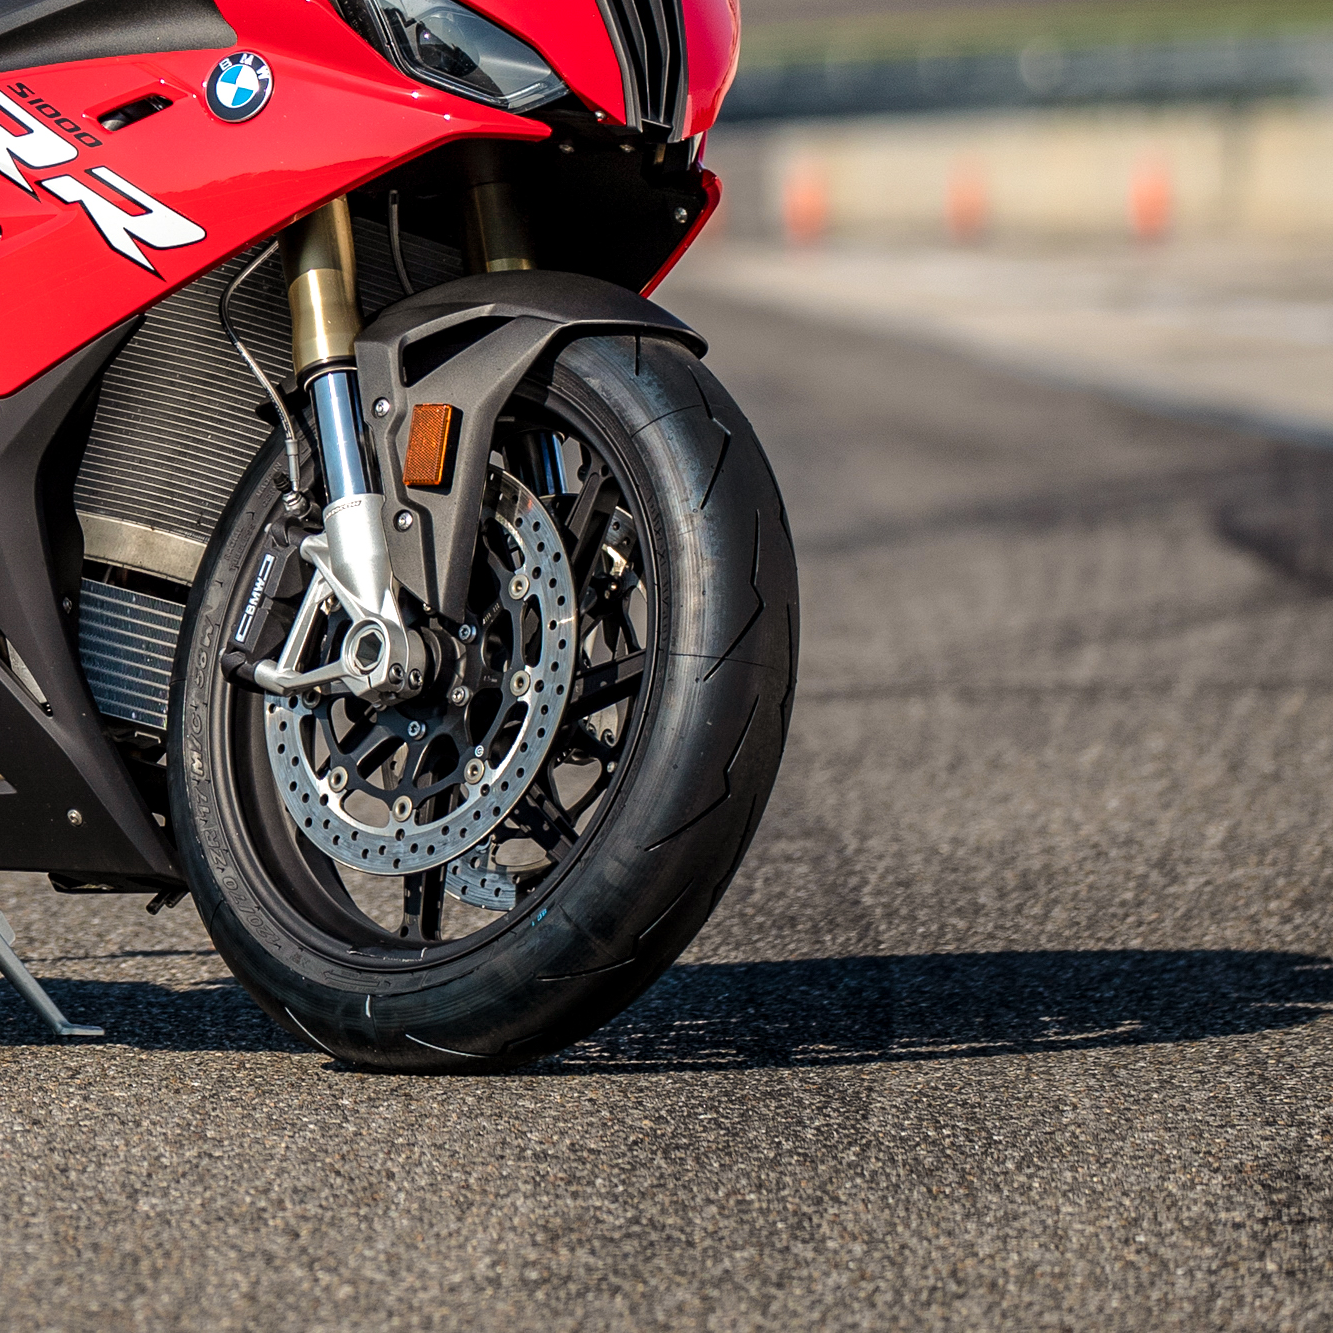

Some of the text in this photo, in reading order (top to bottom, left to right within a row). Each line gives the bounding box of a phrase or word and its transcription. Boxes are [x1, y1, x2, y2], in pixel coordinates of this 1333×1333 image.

[219, 53, 270, 81] BMW
[7, 82, 103, 148] S1000
[244, 576, 267, 616] BMW
[188, 712, 205, 779] M/C
[204, 828, 229, 867] ZR
[223, 875, 281, 947] 120/70
